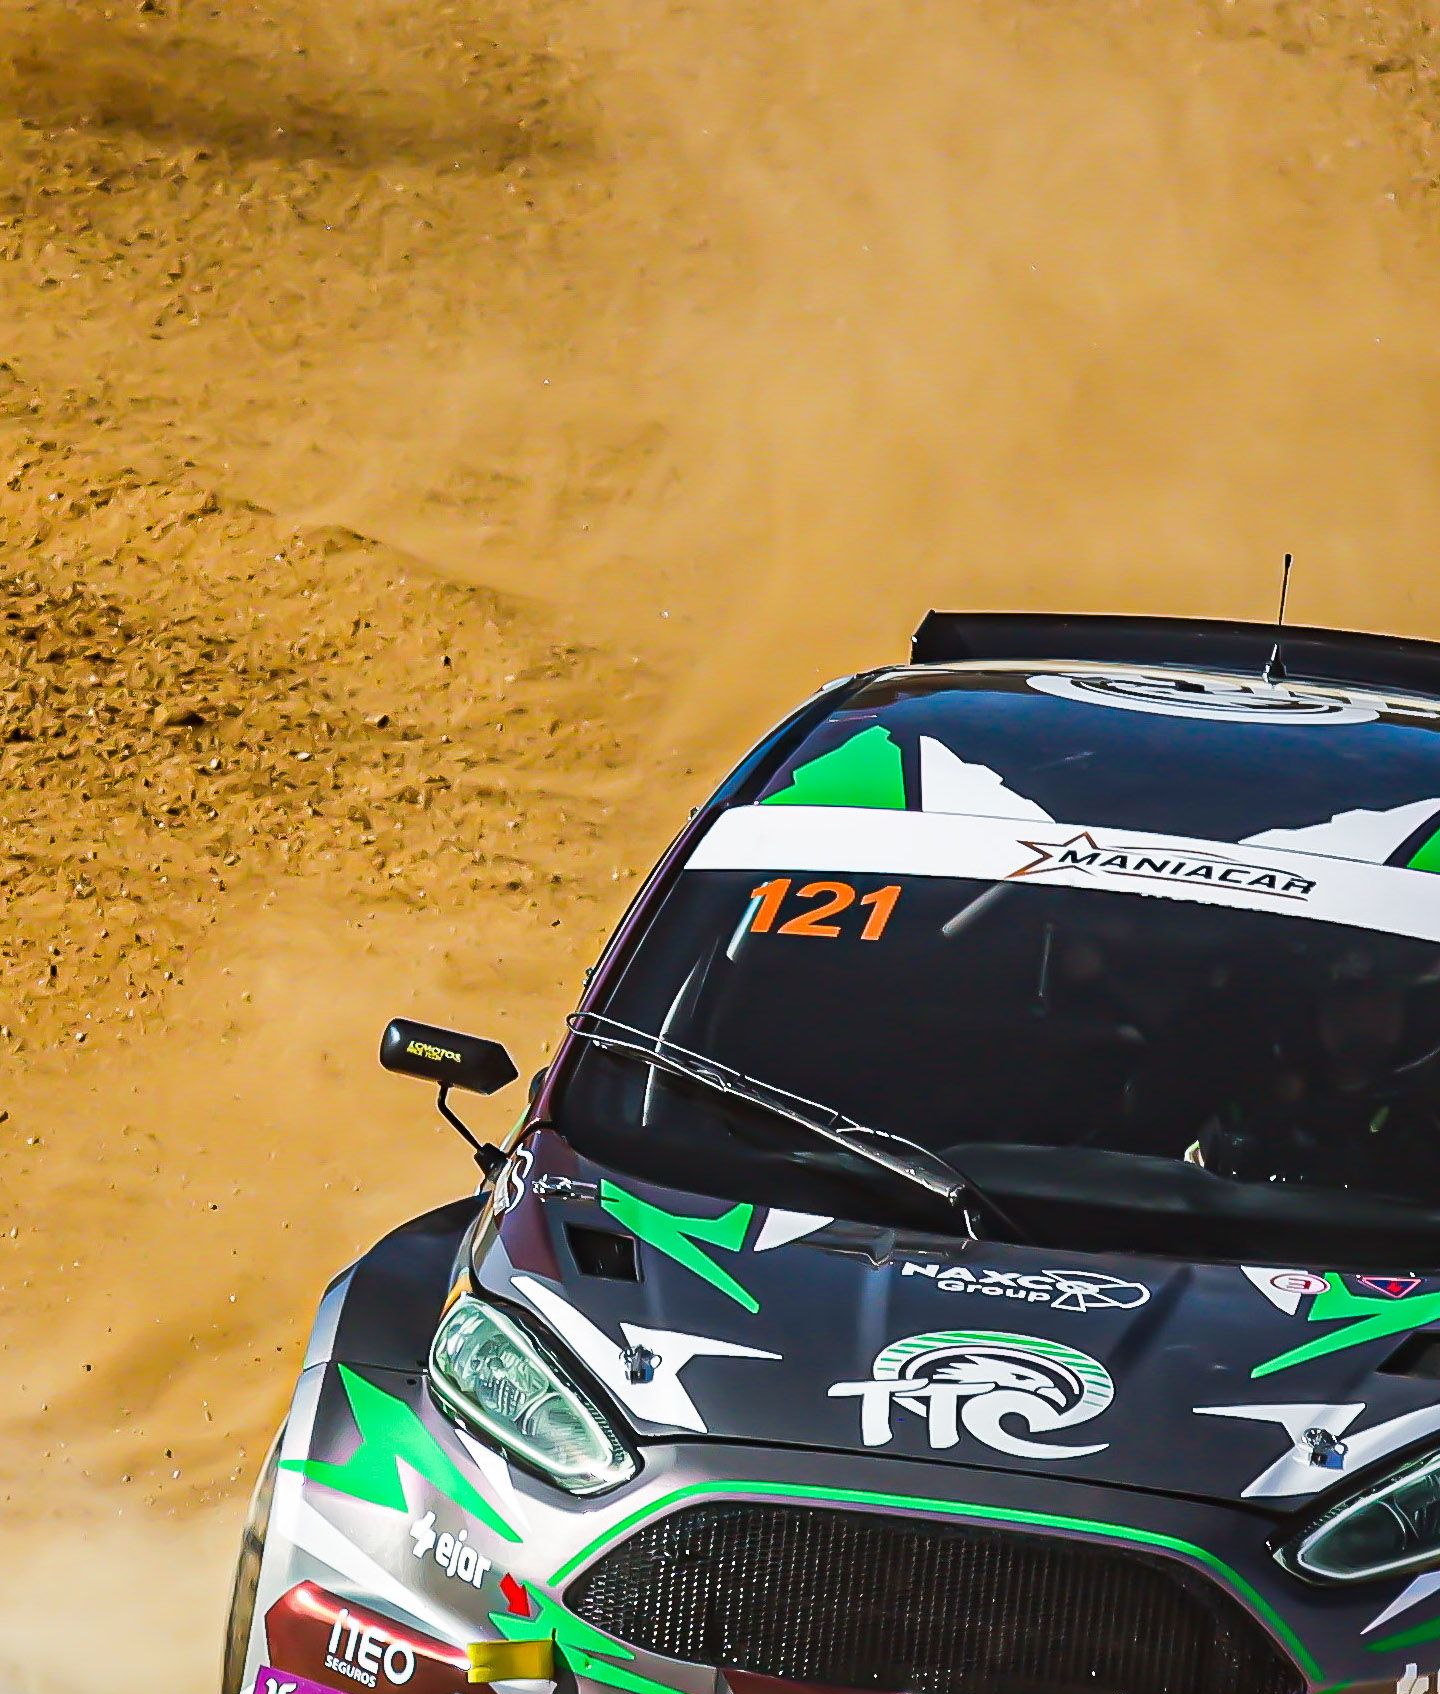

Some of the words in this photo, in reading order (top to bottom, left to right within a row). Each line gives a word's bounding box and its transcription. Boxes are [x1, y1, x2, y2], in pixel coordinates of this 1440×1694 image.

[1058, 850, 1317, 895] MANIACAR
[749, 878, 901, 941] 121
[937, 1280, 1051, 1303] Group
[325, 1655, 377, 1688] SEGUROS
